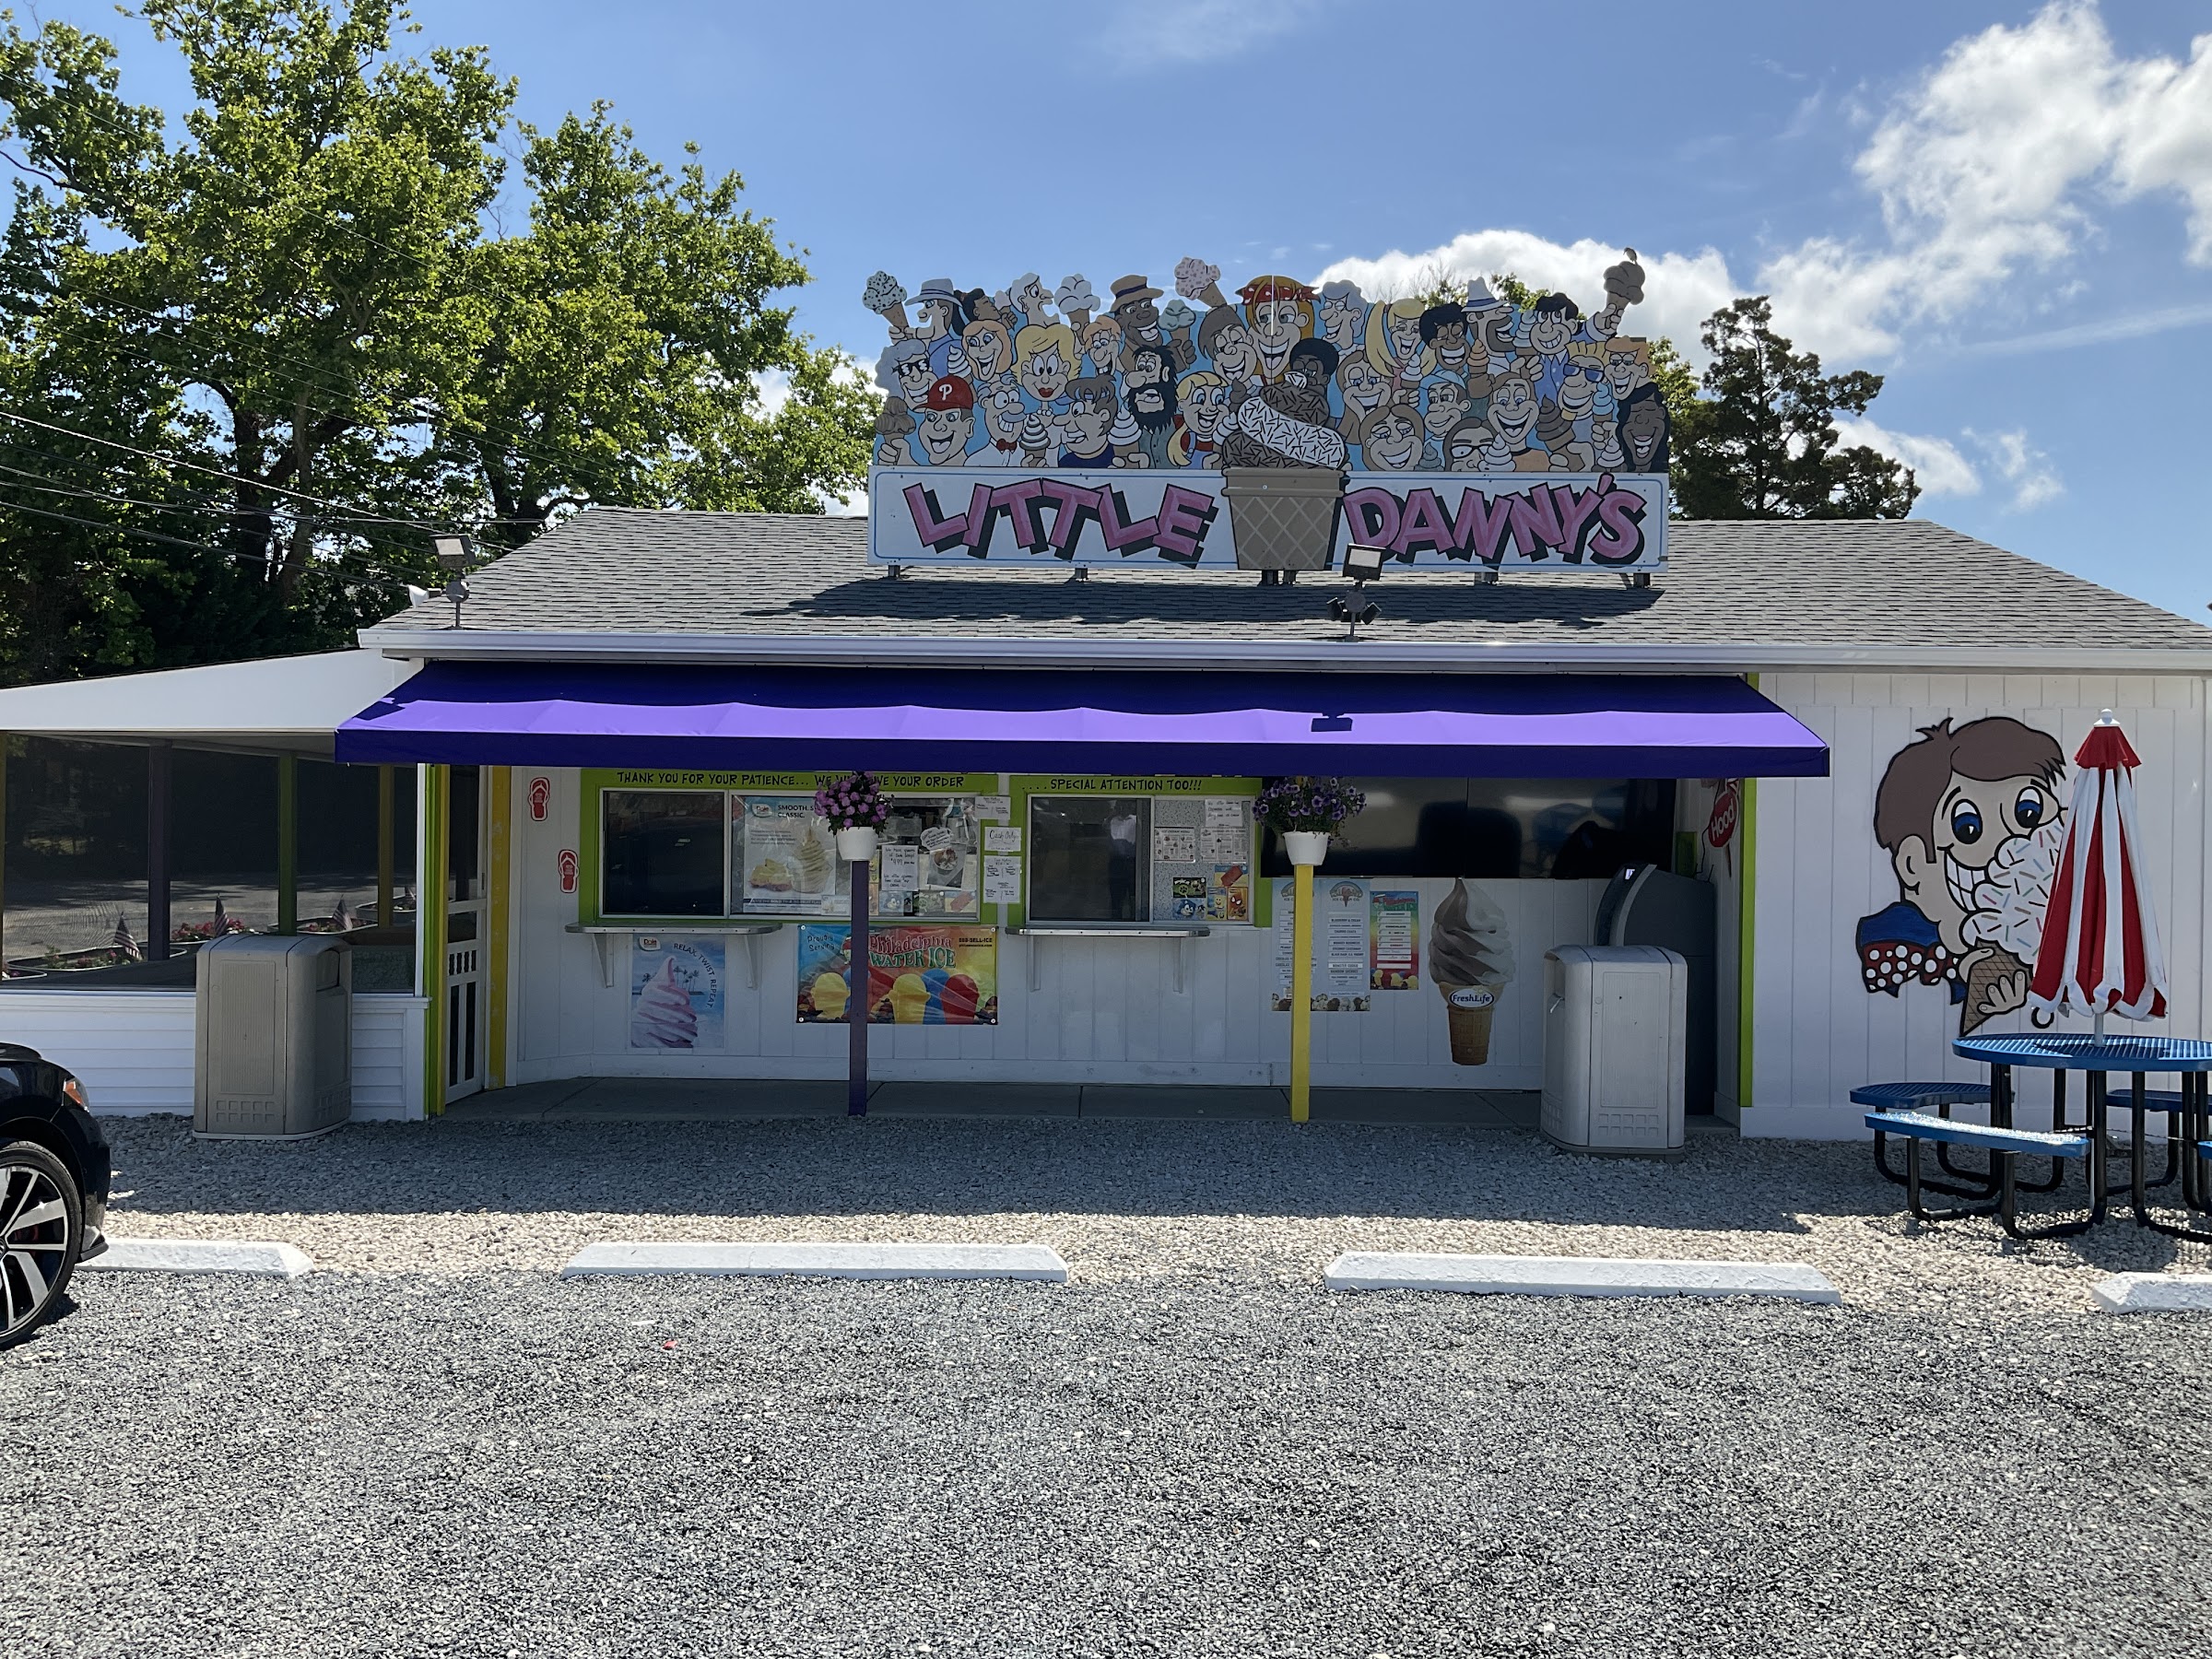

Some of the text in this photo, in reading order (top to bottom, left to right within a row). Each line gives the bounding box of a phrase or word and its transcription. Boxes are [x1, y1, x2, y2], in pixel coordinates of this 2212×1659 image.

[938, 383, 953, 401] P
[902, 473, 1647, 570] LITTLE DANNY'S
[617, 771, 653, 783] THANK
[658, 772, 678, 783] YOU
[682, 773, 703, 784] FOR
[709, 773, 737, 784] YOUR
[741, 775, 809, 785] PATIENCE...
[815, 775, 832, 785] WE
[893, 776, 922, 787] YOUR
[925, 776, 965, 787] ORDER
[1100, 780, 1162, 790] ATTENTION
[1167, 780, 1202, 790] TOO!!!
[1712, 797, 1735, 841] Hood
[807, 933, 833, 943] Proudly
[869, 935, 952, 954] Philadelphia
[808, 943, 835, 951] Serving
[868, 946, 956, 968] WATER ICE
[1453, 994, 1490, 1004] FreshLife
